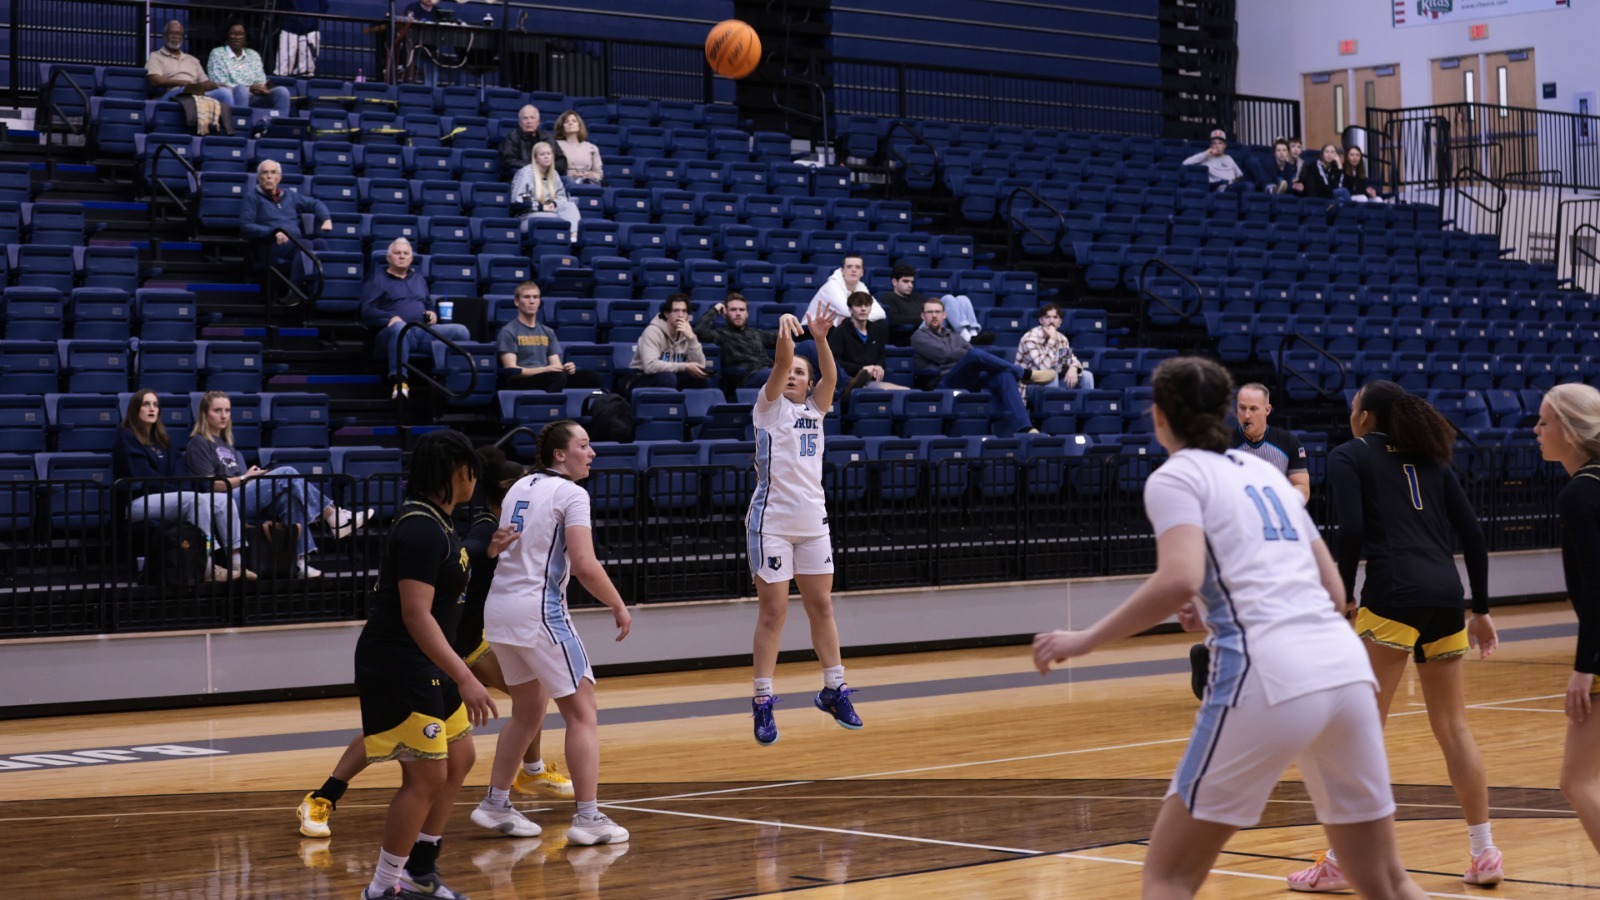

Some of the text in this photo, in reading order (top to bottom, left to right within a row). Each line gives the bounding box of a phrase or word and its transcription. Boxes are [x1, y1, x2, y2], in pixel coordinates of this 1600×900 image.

[799, 433, 819, 457] 15
[1403, 463, 1424, 511] 1
[510, 500, 530, 534] 5
[1244, 485, 1299, 541] 11
